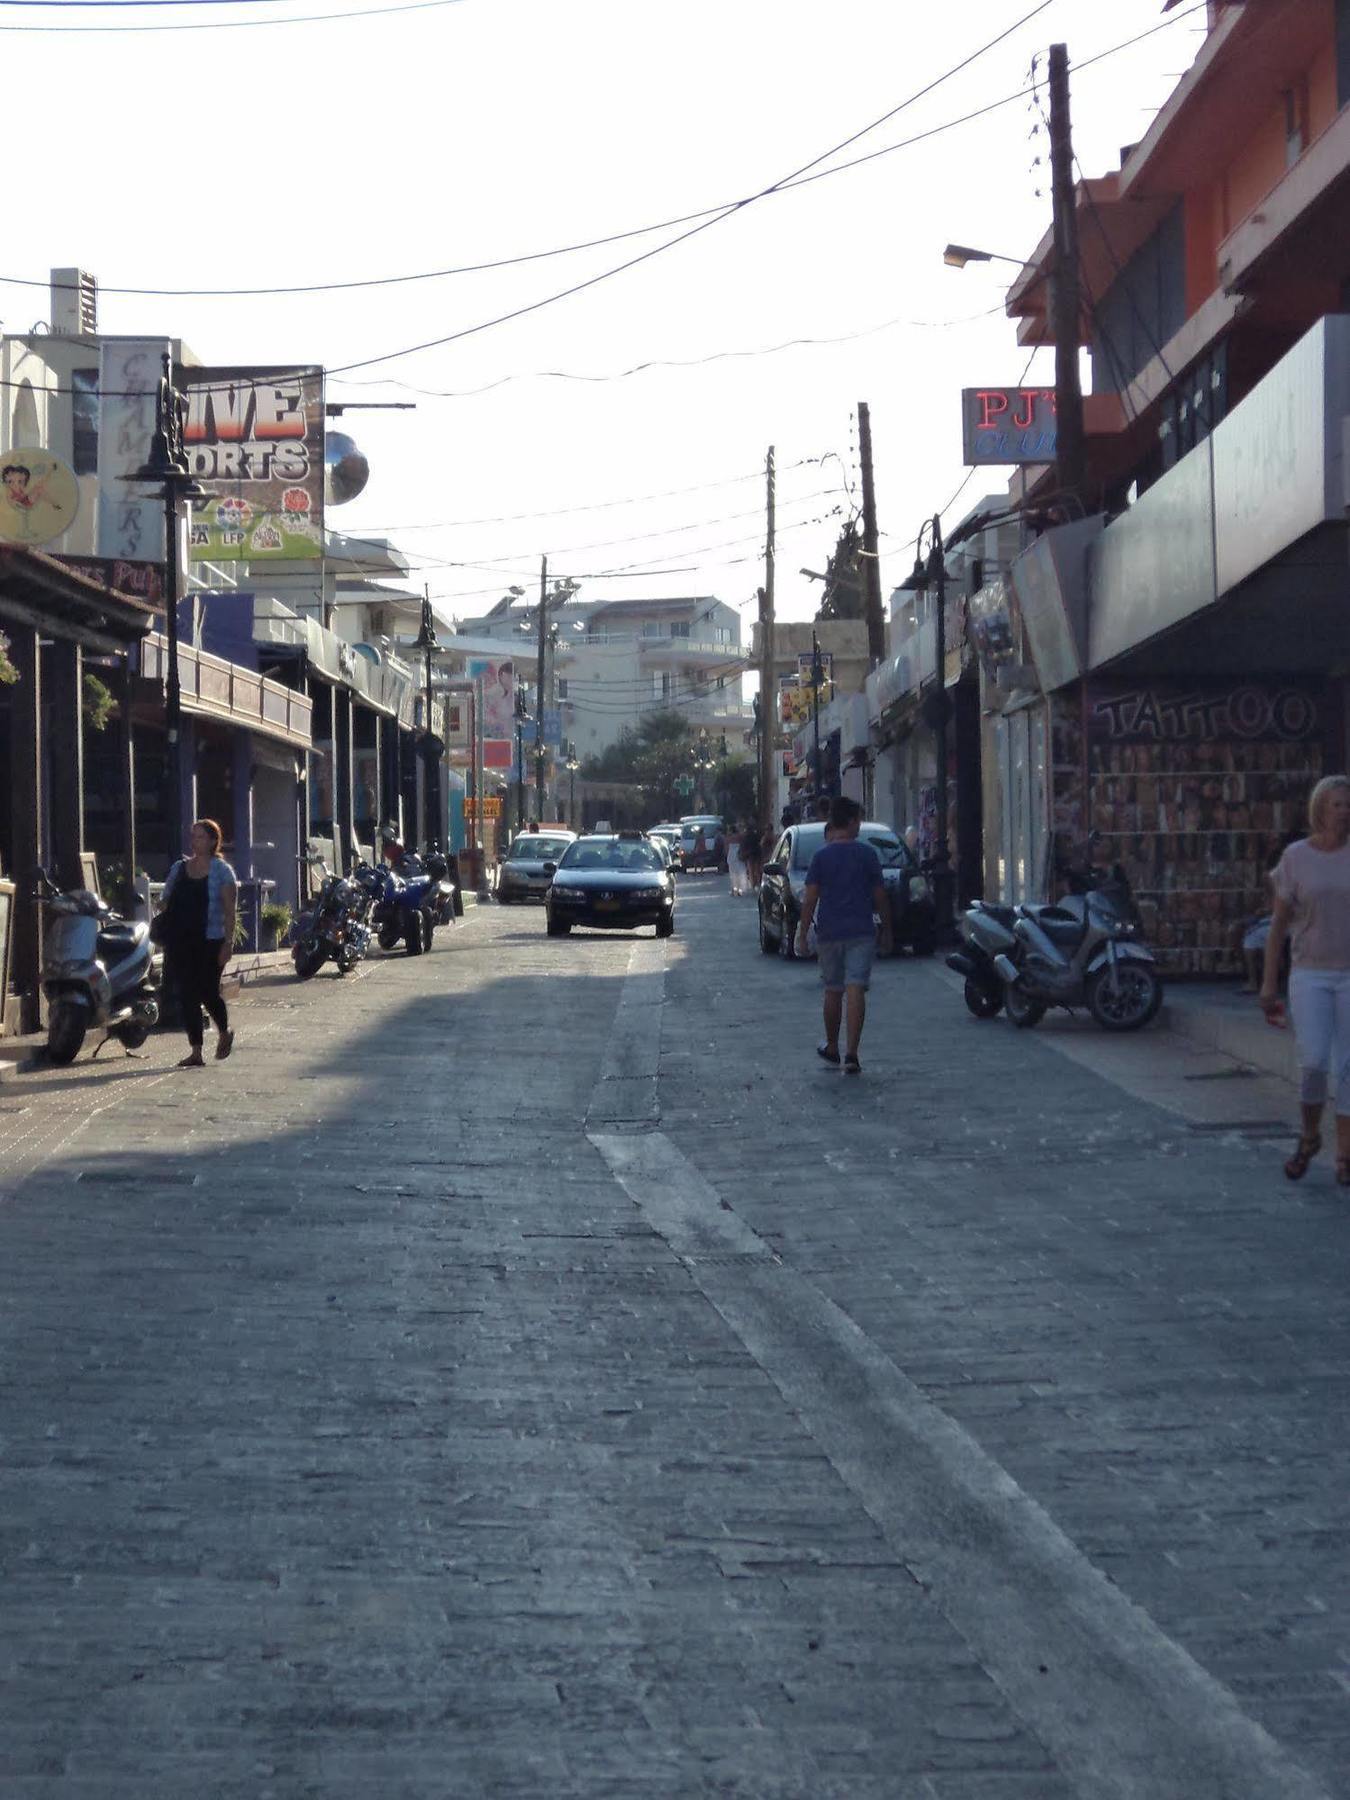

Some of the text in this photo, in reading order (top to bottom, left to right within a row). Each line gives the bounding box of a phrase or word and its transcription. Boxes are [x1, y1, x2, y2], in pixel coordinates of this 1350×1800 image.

[183, 378, 307, 442] IVE
[187, 440, 309, 481] ORTS
[223, 531, 246, 545] LFP
[1093, 686, 1317, 742] TATTOO
